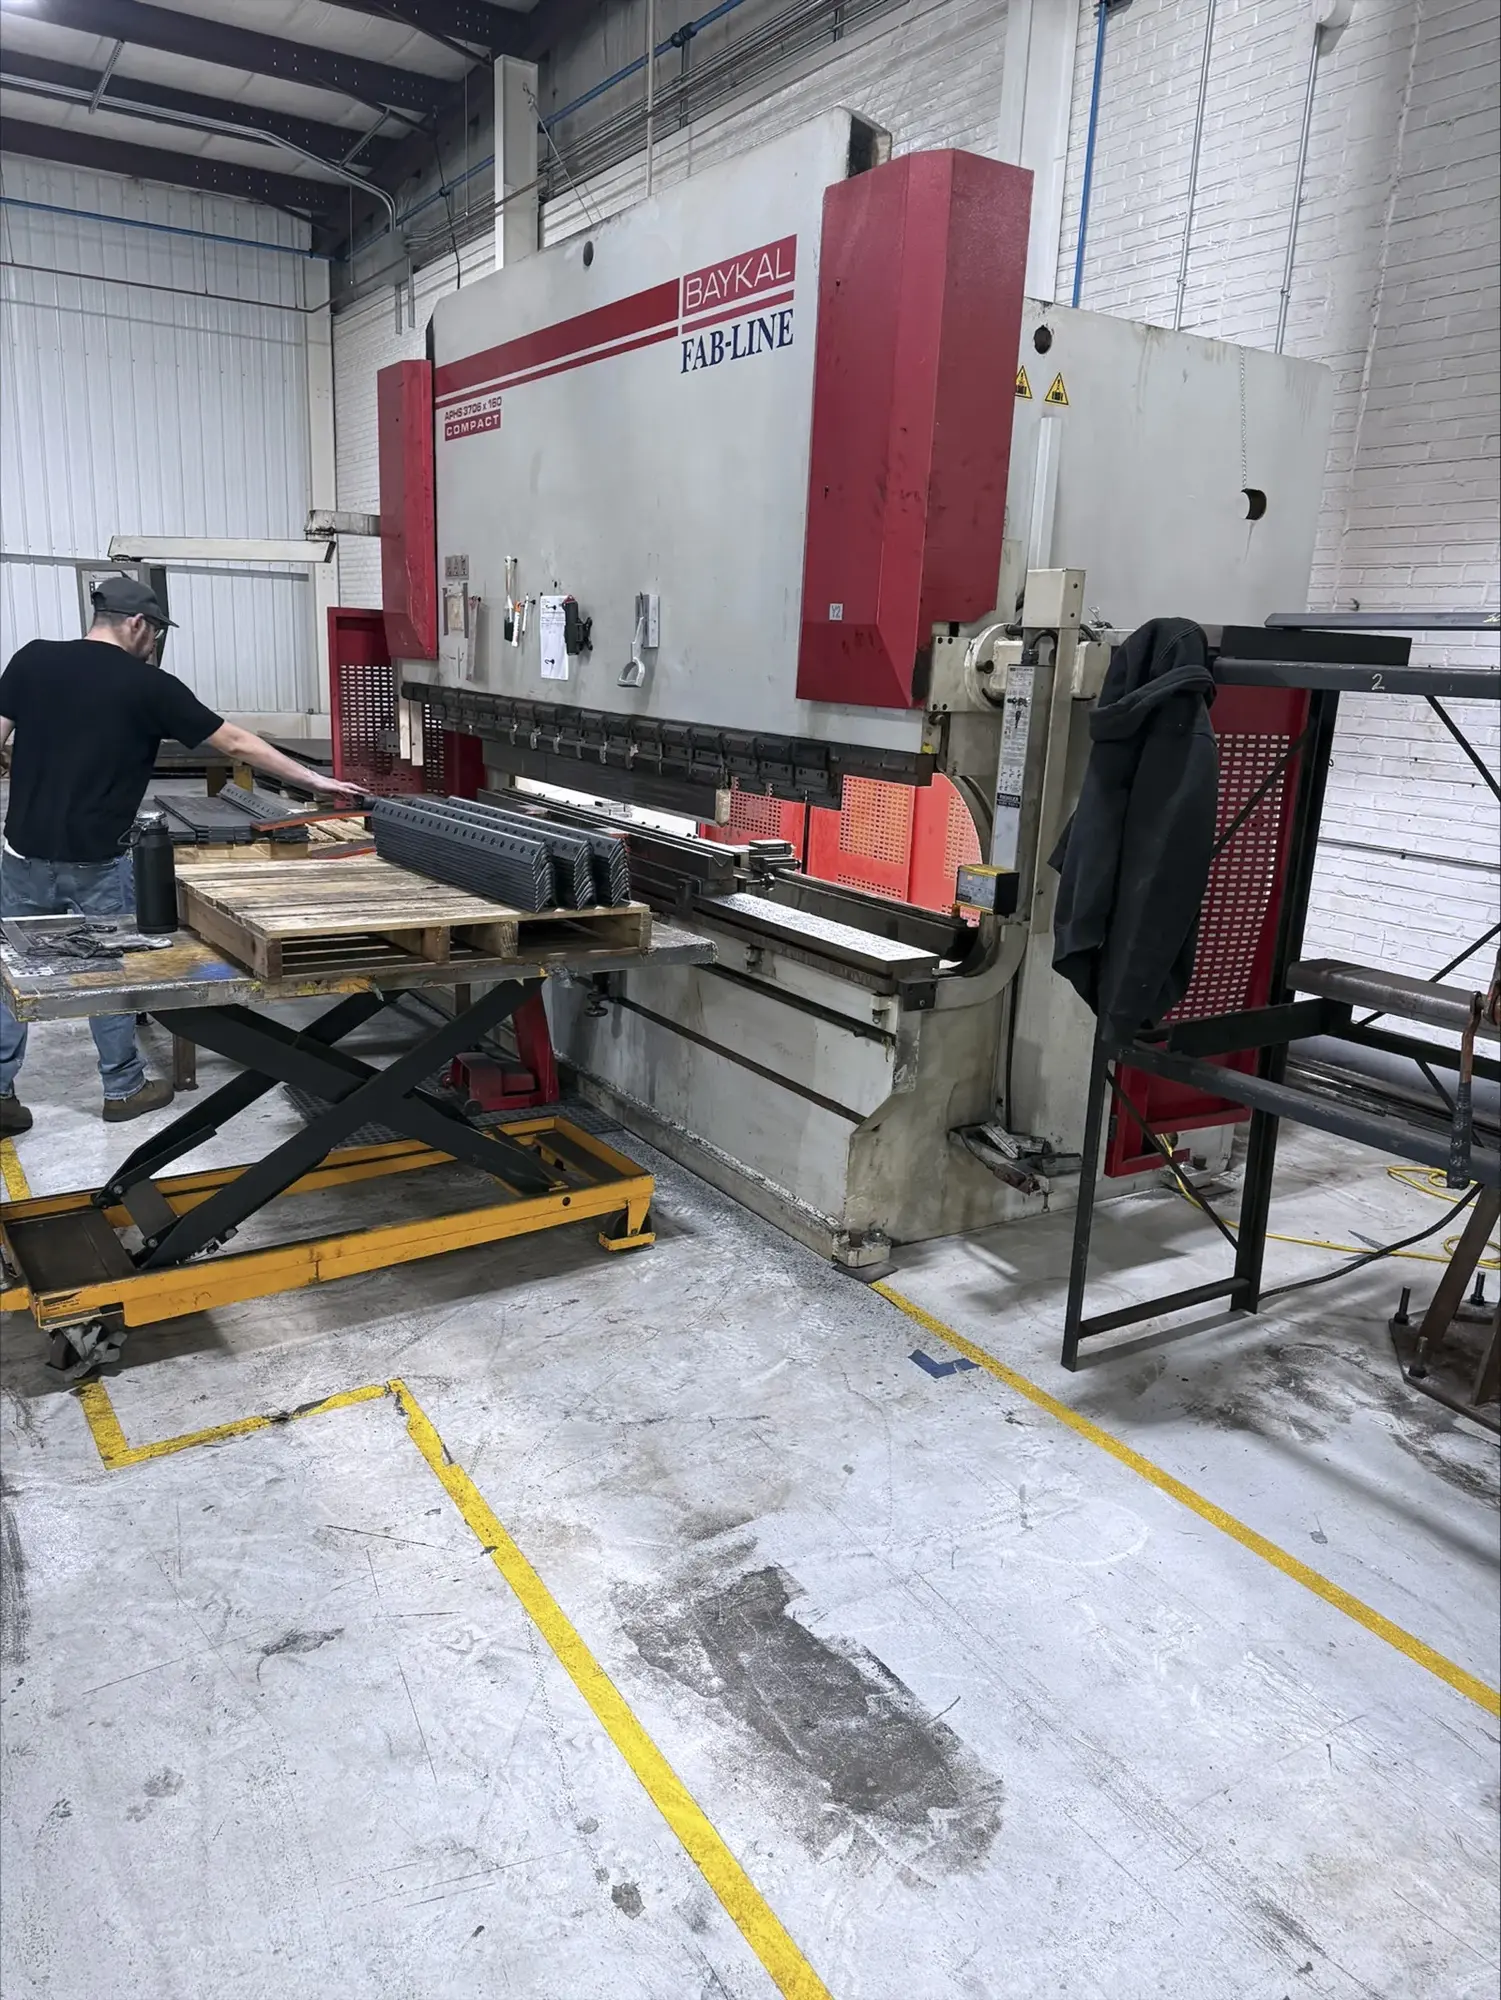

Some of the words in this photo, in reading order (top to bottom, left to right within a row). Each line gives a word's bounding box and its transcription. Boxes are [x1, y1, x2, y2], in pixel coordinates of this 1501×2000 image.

[686, 248, 791, 309] BAYKAL
[681, 308, 794, 374] FAB-LINE
[446, 414, 499, 437] COMPACT
[1371, 673, 1386, 691] 2
